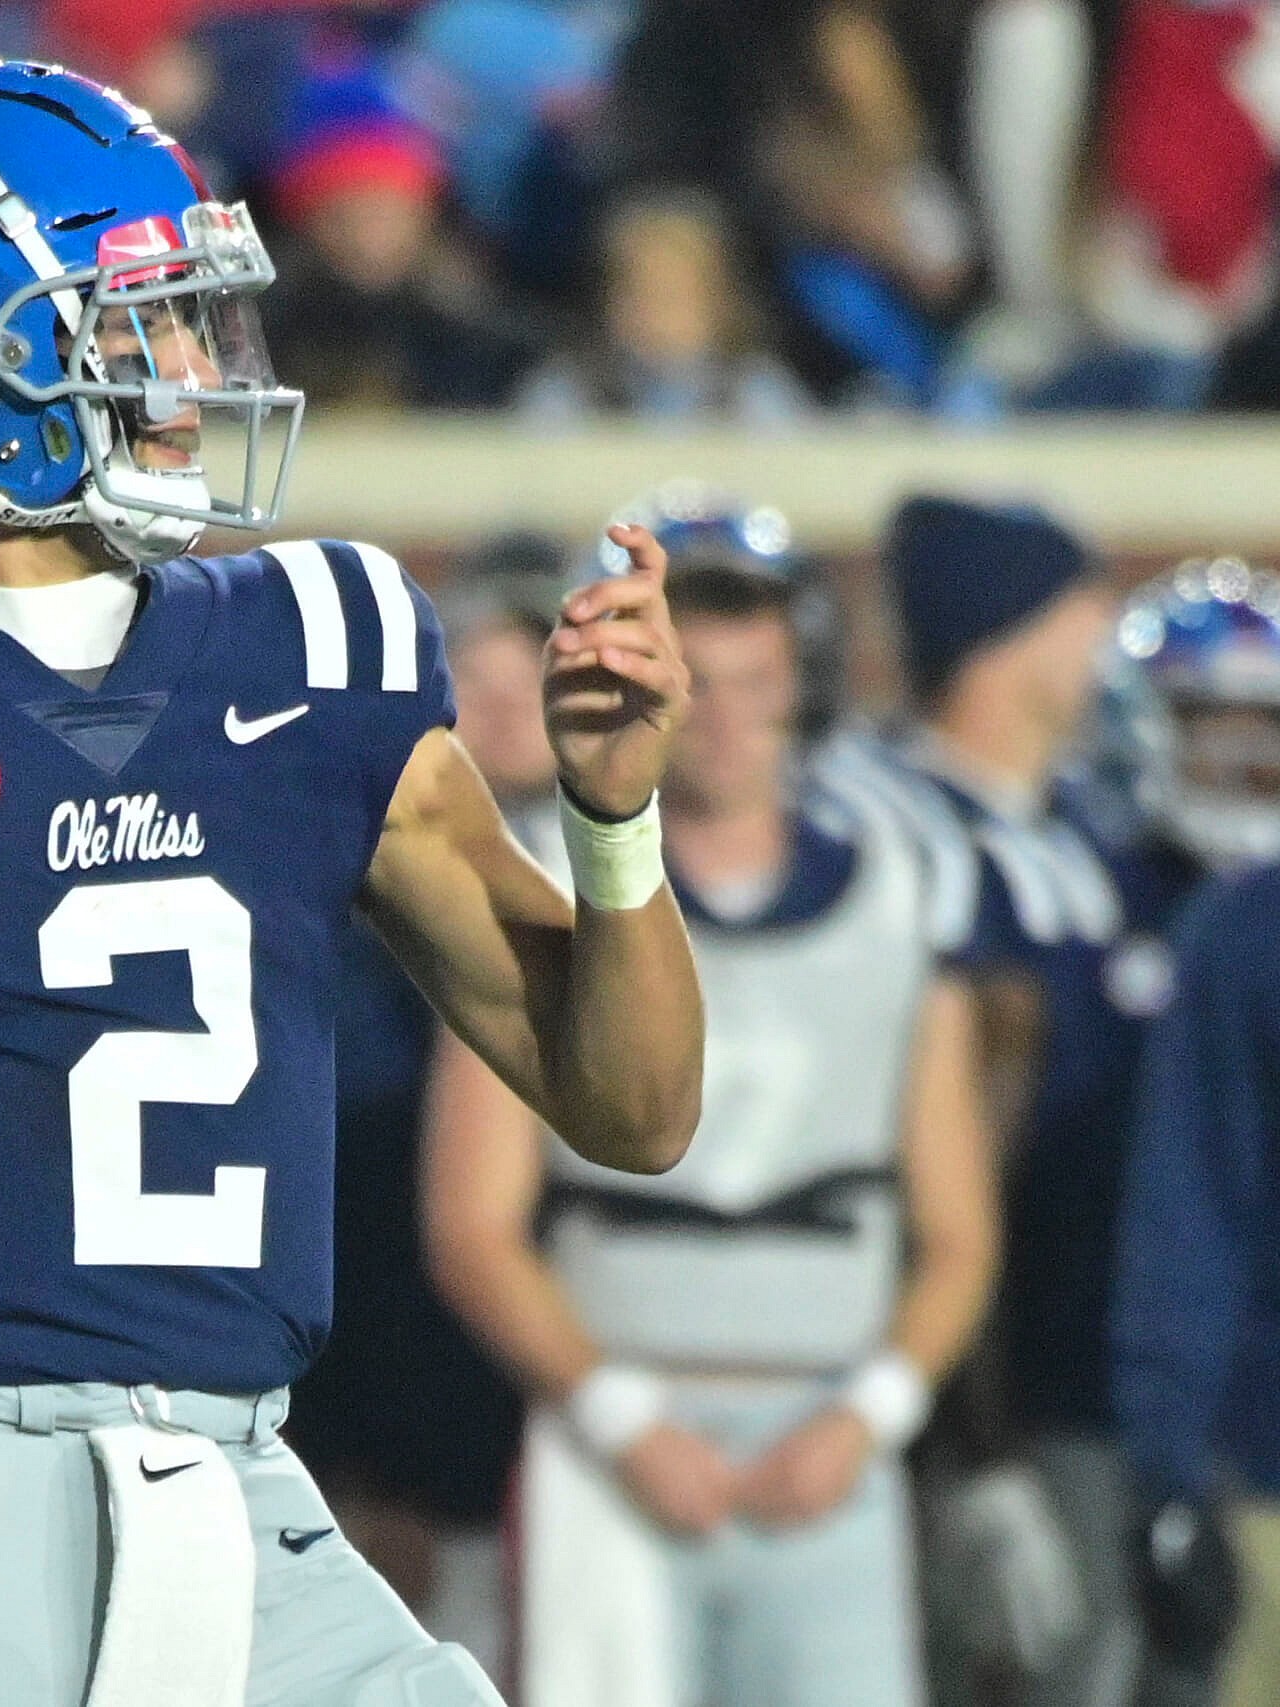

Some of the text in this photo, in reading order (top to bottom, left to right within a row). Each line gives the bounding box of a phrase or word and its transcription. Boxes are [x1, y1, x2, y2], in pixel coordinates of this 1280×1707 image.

[48, 793, 205, 872] Ole Miss
[38, 875, 266, 1268] 2
